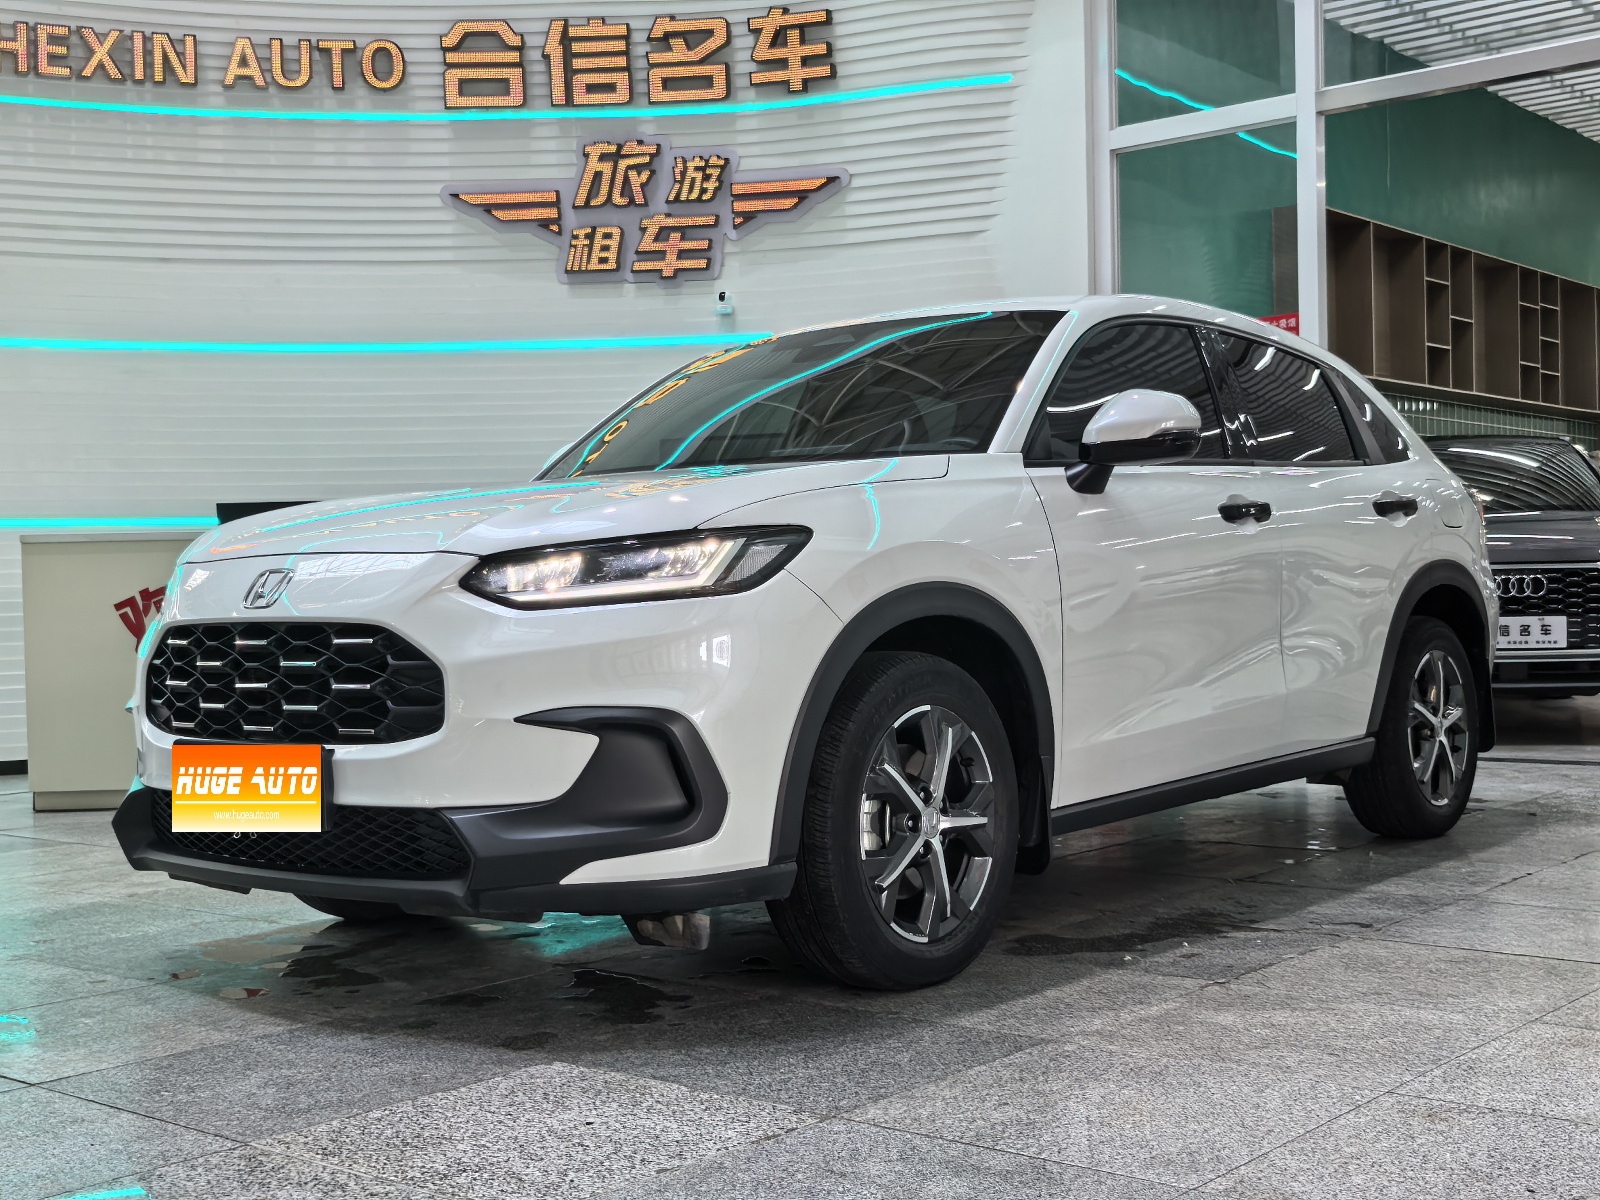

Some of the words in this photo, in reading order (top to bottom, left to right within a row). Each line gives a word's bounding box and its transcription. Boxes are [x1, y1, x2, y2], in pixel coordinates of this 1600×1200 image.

[0, 21, 197, 84] HEXIN
[222, 36, 405, 91] AUTO
[440, 6, 837, 108] 合信名车
[572, 139, 731, 209] 旅游
[564, 213, 720, 280] 租车
